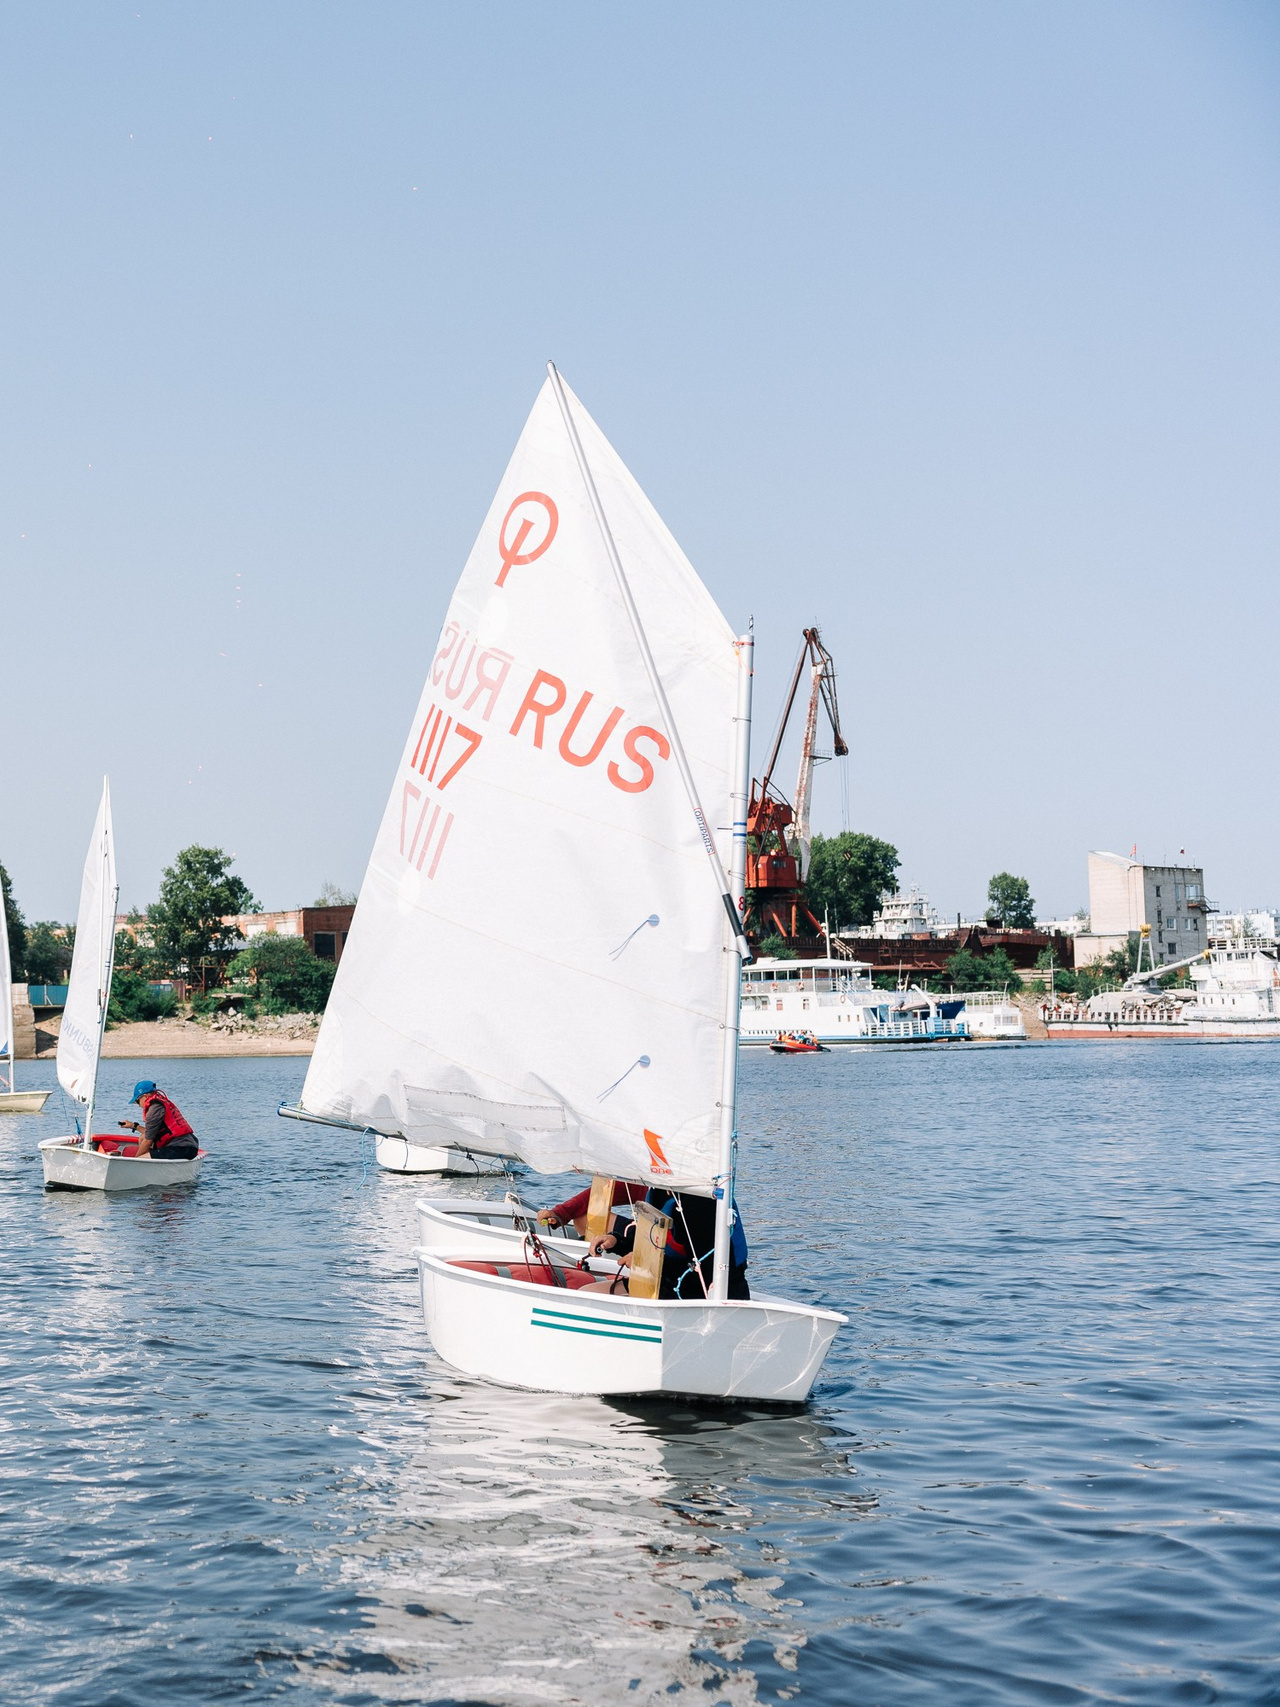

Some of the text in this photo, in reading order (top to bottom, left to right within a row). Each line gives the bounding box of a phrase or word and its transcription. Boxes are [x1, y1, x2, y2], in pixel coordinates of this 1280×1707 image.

[411, 703, 483, 791] 1117
[509, 668, 671, 794] RUS
[693, 810, 714, 855] OPTIPARTS
